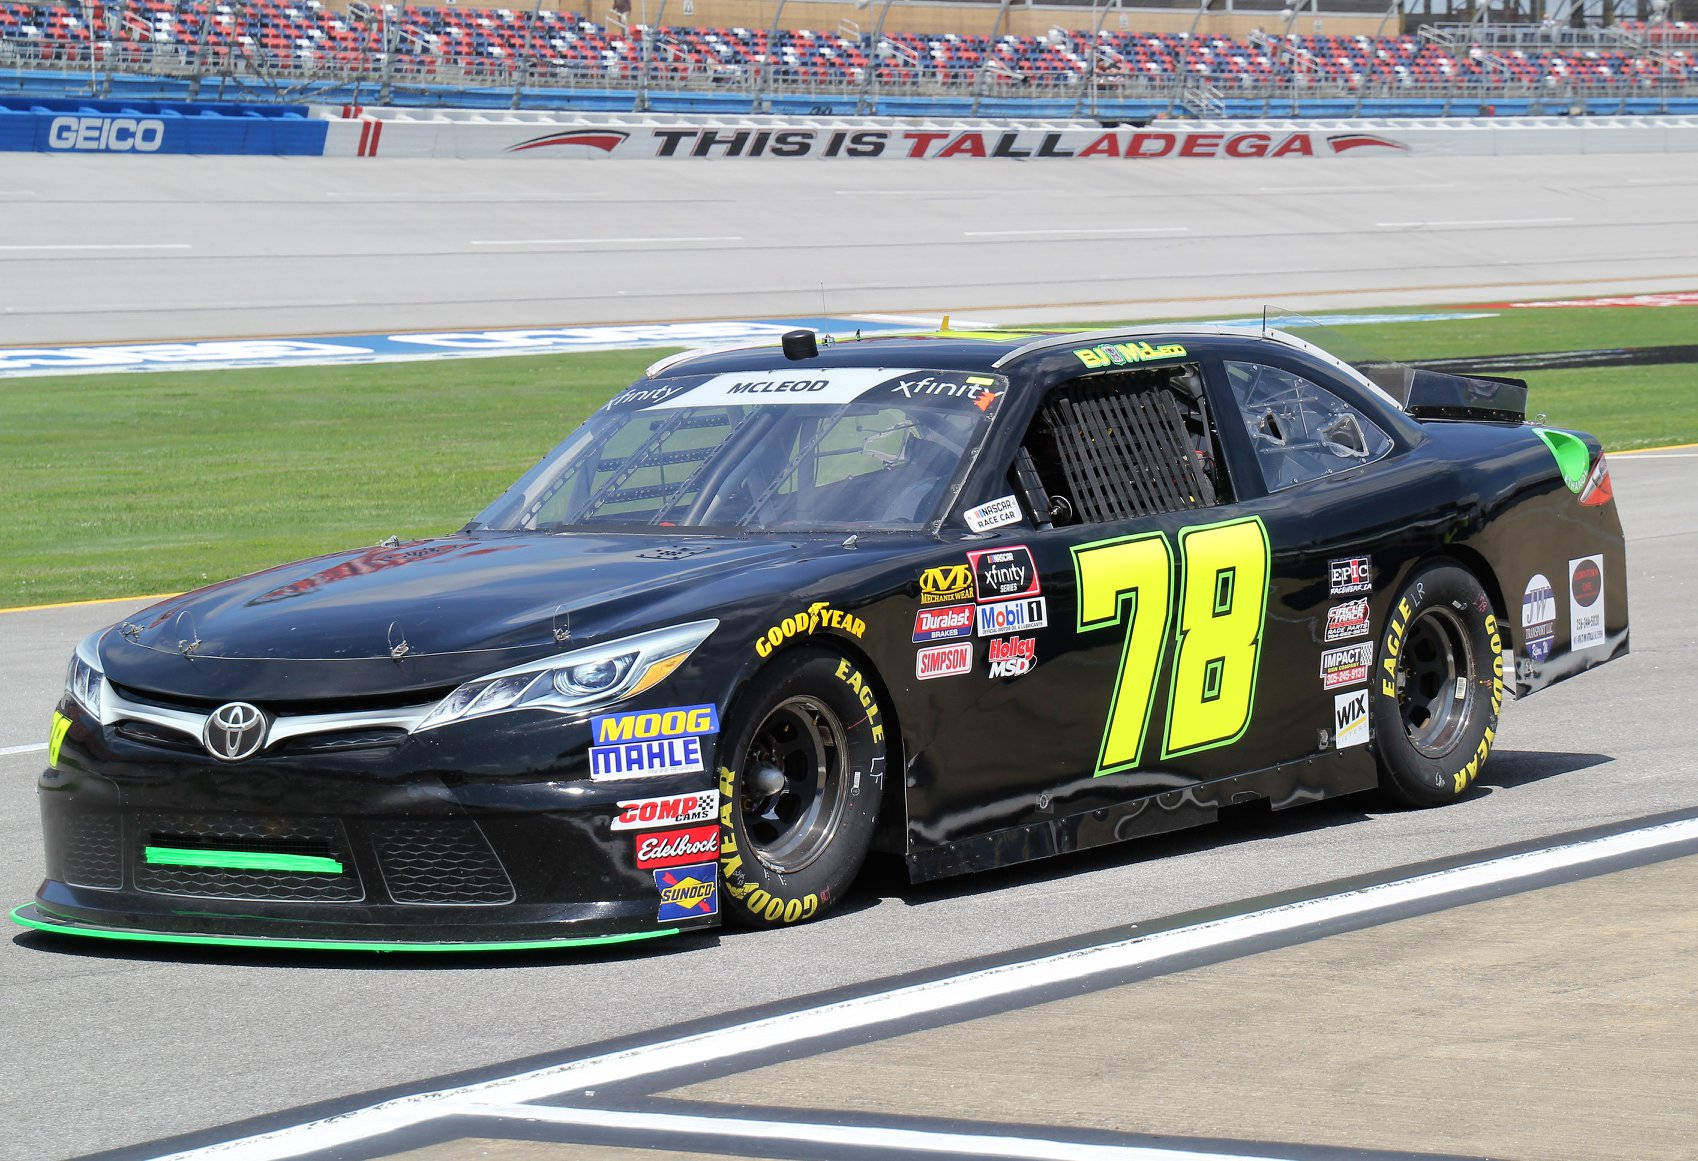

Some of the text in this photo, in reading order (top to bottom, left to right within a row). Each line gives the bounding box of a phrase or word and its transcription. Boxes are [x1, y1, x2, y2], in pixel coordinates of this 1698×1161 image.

[49, 117, 165, 152] GEICO
[653, 129, 1313, 158] THIS IS TALLADEGA
[600, 385, 684, 411] xfinity
[726, 380, 830, 395] MCLEOD
[978, 510, 1016, 529] RACE CAR
[981, 499, 1013, 517] NASCAR
[984, 563, 1025, 590] xfinity
[1331, 564, 1369, 582] EPIC
[920, 585, 975, 605] MECHANIX WEAR
[1000, 582, 1018, 593] SERIES
[919, 608, 970, 631] Duralast
[981, 601, 1038, 630] Mobil 1
[1329, 602, 1365, 616] CIRCLE
[755, 602, 866, 658] GOODYEAR
[930, 628, 959, 639] BRAKES
[989, 635, 1036, 662] Holley
[1069, 514, 1271, 778] 78
[1323, 647, 1361, 669] IMPACT
[1382, 597, 1412, 699] EAGLE
[920, 648, 968, 674] SIMPSON
[988, 657, 1030, 679] MSD
[834, 657, 886, 744] EAGLE
[1337, 693, 1366, 730] WIX
[599, 708, 711, 743] MOOG
[591, 738, 700, 775] MAHLE
[618, 796, 698, 824] COMP
[675, 810, 709, 822] CAMS
[638, 831, 718, 861] Edelbrock
[719, 766, 818, 923] GOODYEAR
[661, 882, 715, 902] SUNOCO
